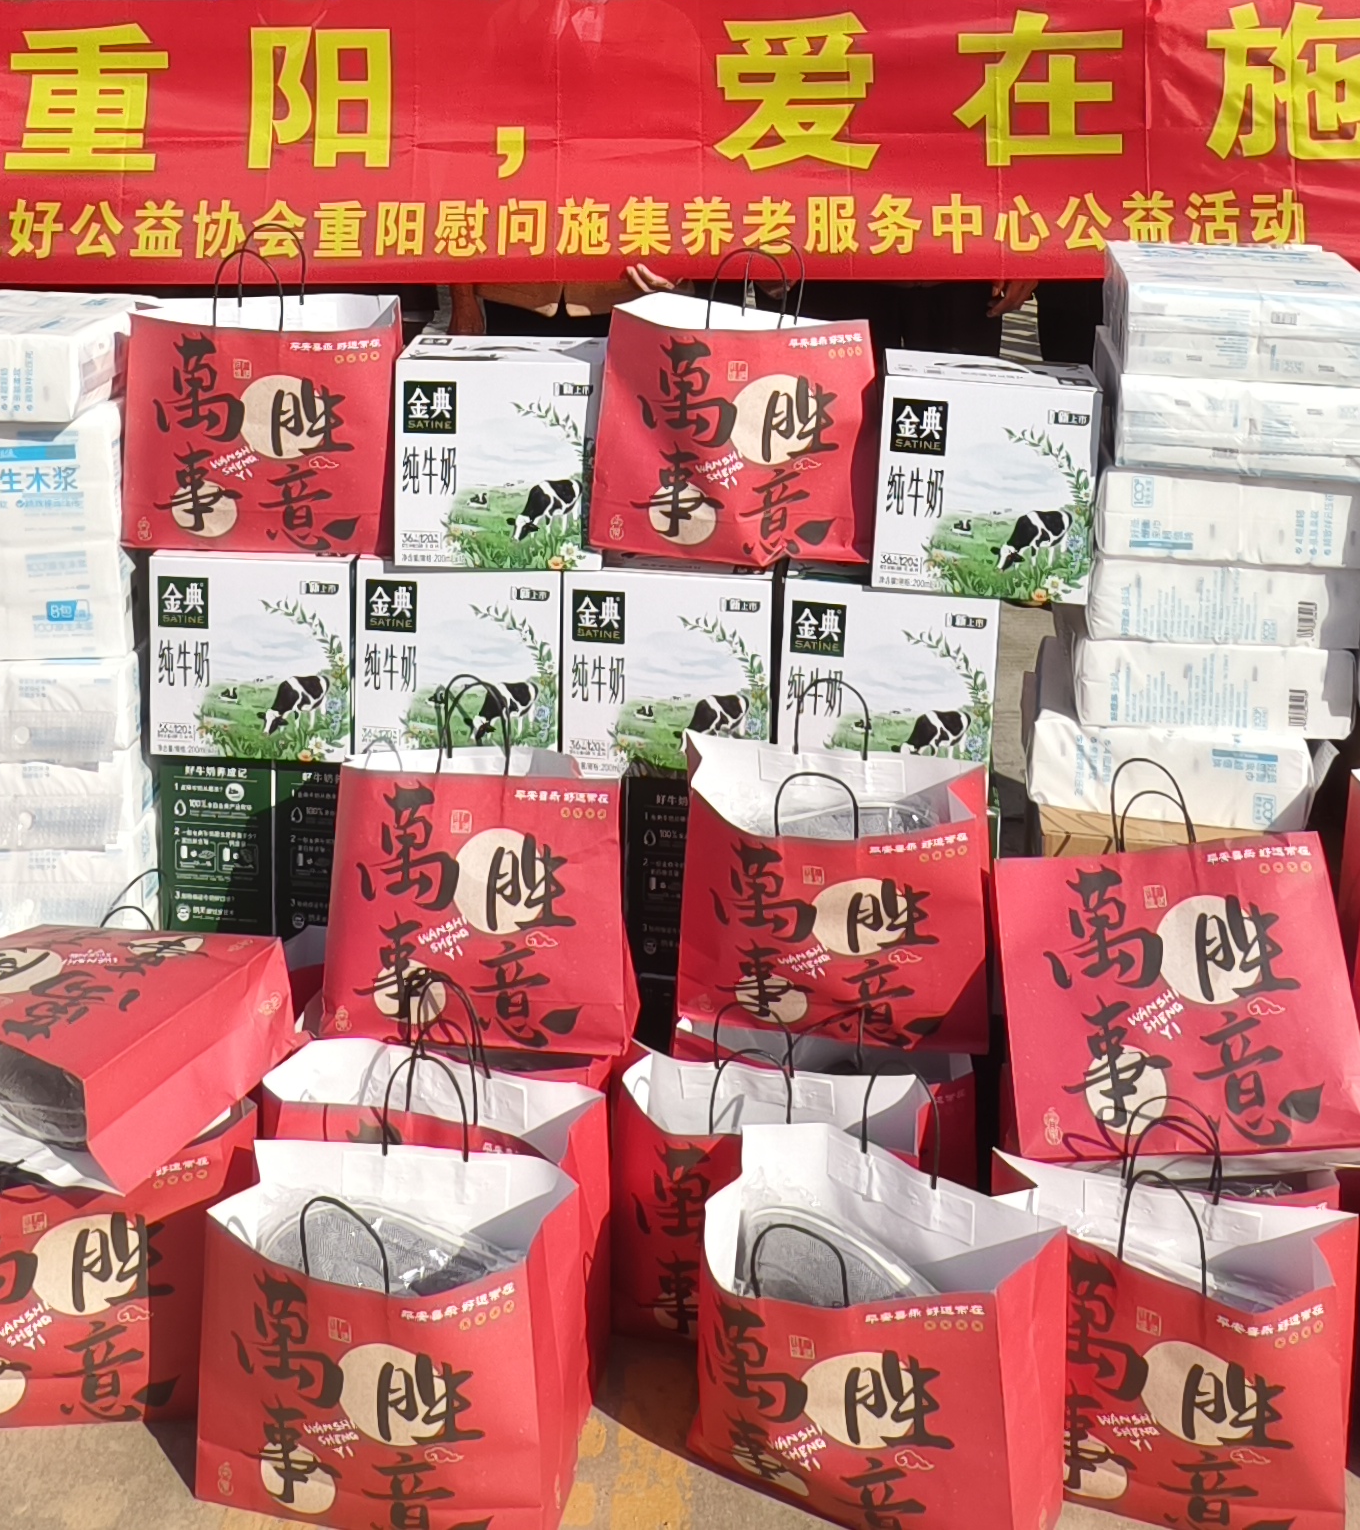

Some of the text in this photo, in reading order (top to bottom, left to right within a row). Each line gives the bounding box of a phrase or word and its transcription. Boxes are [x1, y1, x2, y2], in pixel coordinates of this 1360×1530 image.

[406, 385, 453, 418] 金典
[407, 420, 452, 430] SATINE
[895, 406, 943, 439] 金典
[895, 440, 941, 451] SATINE
[235, 468, 253, 481] YI
[402, 446, 458, 496] 纯牛奶
[885, 465, 943, 519] 纯牛奶
[161, 582, 205, 615] 金典
[368, 584, 413, 617] 金典
[162, 615, 205, 625] SATINE
[369, 617, 414, 628] SATINE
[576, 597, 622, 629] 金典
[795, 609, 841, 641] 金典
[577, 629, 621, 640] SATINE
[795, 640, 840, 652] SATINE
[157, 640, 210, 688] 纯牛奶
[364, 643, 417, 692] 纯牛奶
[571, 655, 625, 704] 纯牛奶
[787, 667, 843, 718] 纯牛奶
[445, 945, 463, 960] YI
[1160, 1022, 1181, 1040] YI
[23, 1334, 45, 1350] YI
[332, 1445, 353, 1459] YI
[1129, 1438, 1152, 1451] YI
